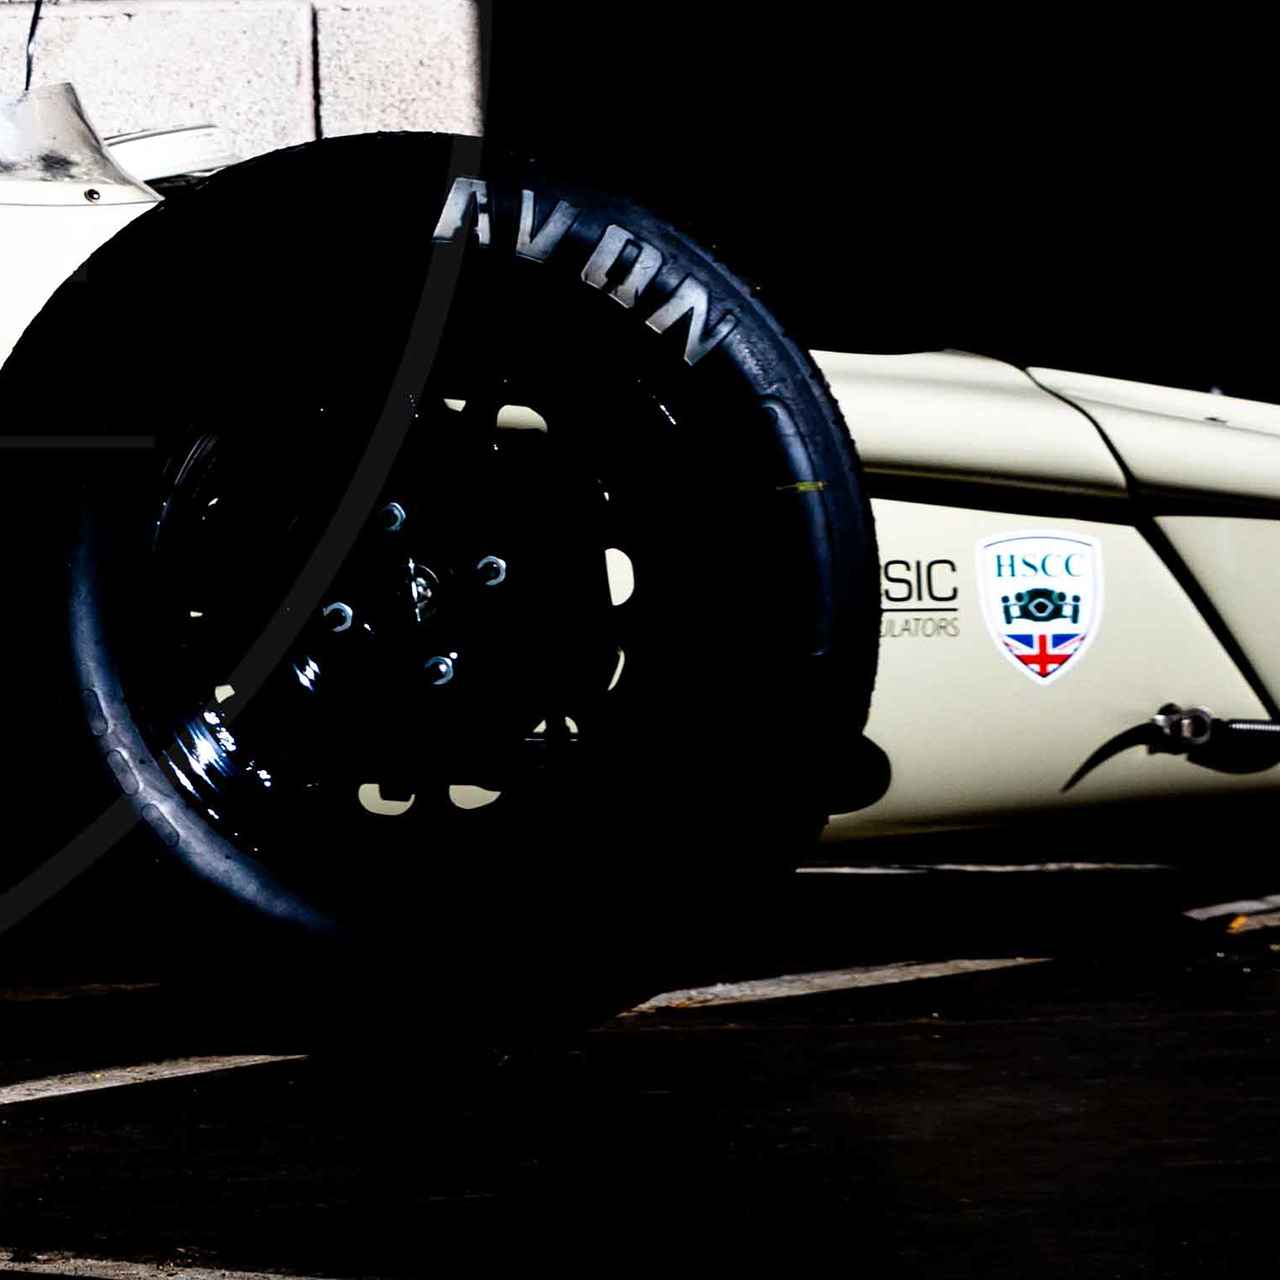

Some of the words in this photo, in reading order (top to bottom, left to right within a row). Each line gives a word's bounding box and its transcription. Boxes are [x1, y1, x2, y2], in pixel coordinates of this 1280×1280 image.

[432, 175, 740, 367] AVON
[882, 558, 958, 602] SIC
[995, 552, 1082, 578] HSCC
